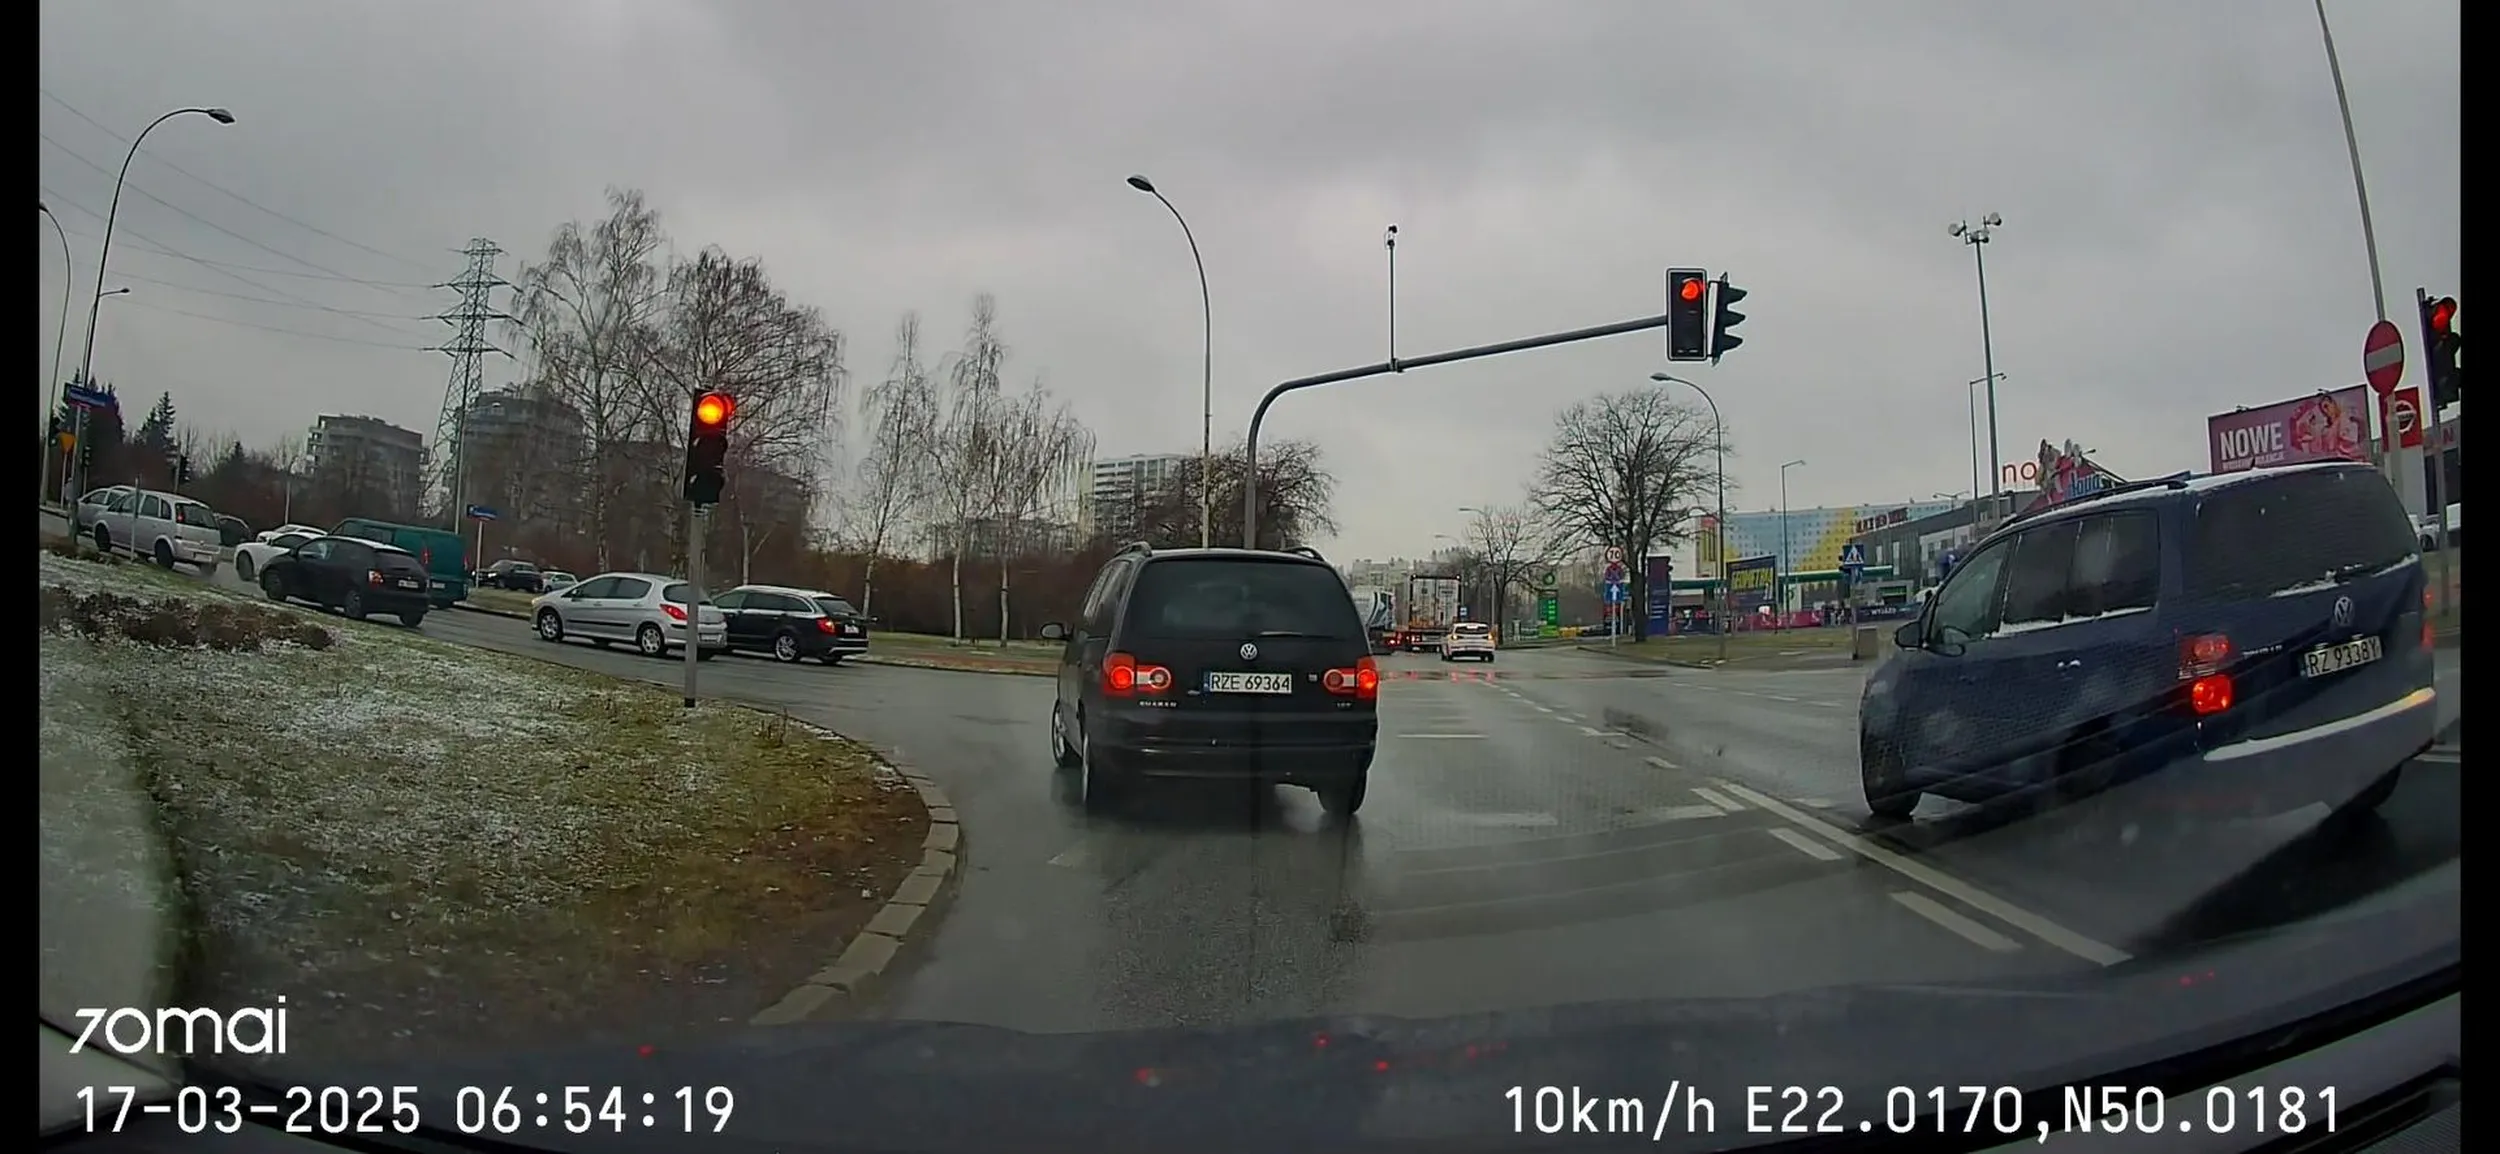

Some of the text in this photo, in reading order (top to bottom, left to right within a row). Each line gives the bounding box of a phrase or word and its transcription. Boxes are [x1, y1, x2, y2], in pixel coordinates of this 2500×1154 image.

[2219, 421, 2284, 461] NOWE
[1608, 550, 1621, 559] 70
[2308, 651, 2330, 675] RZ
[2334, 636, 2378, 668] 9338Y
[1211, 675, 1290, 691] RZE 69364
